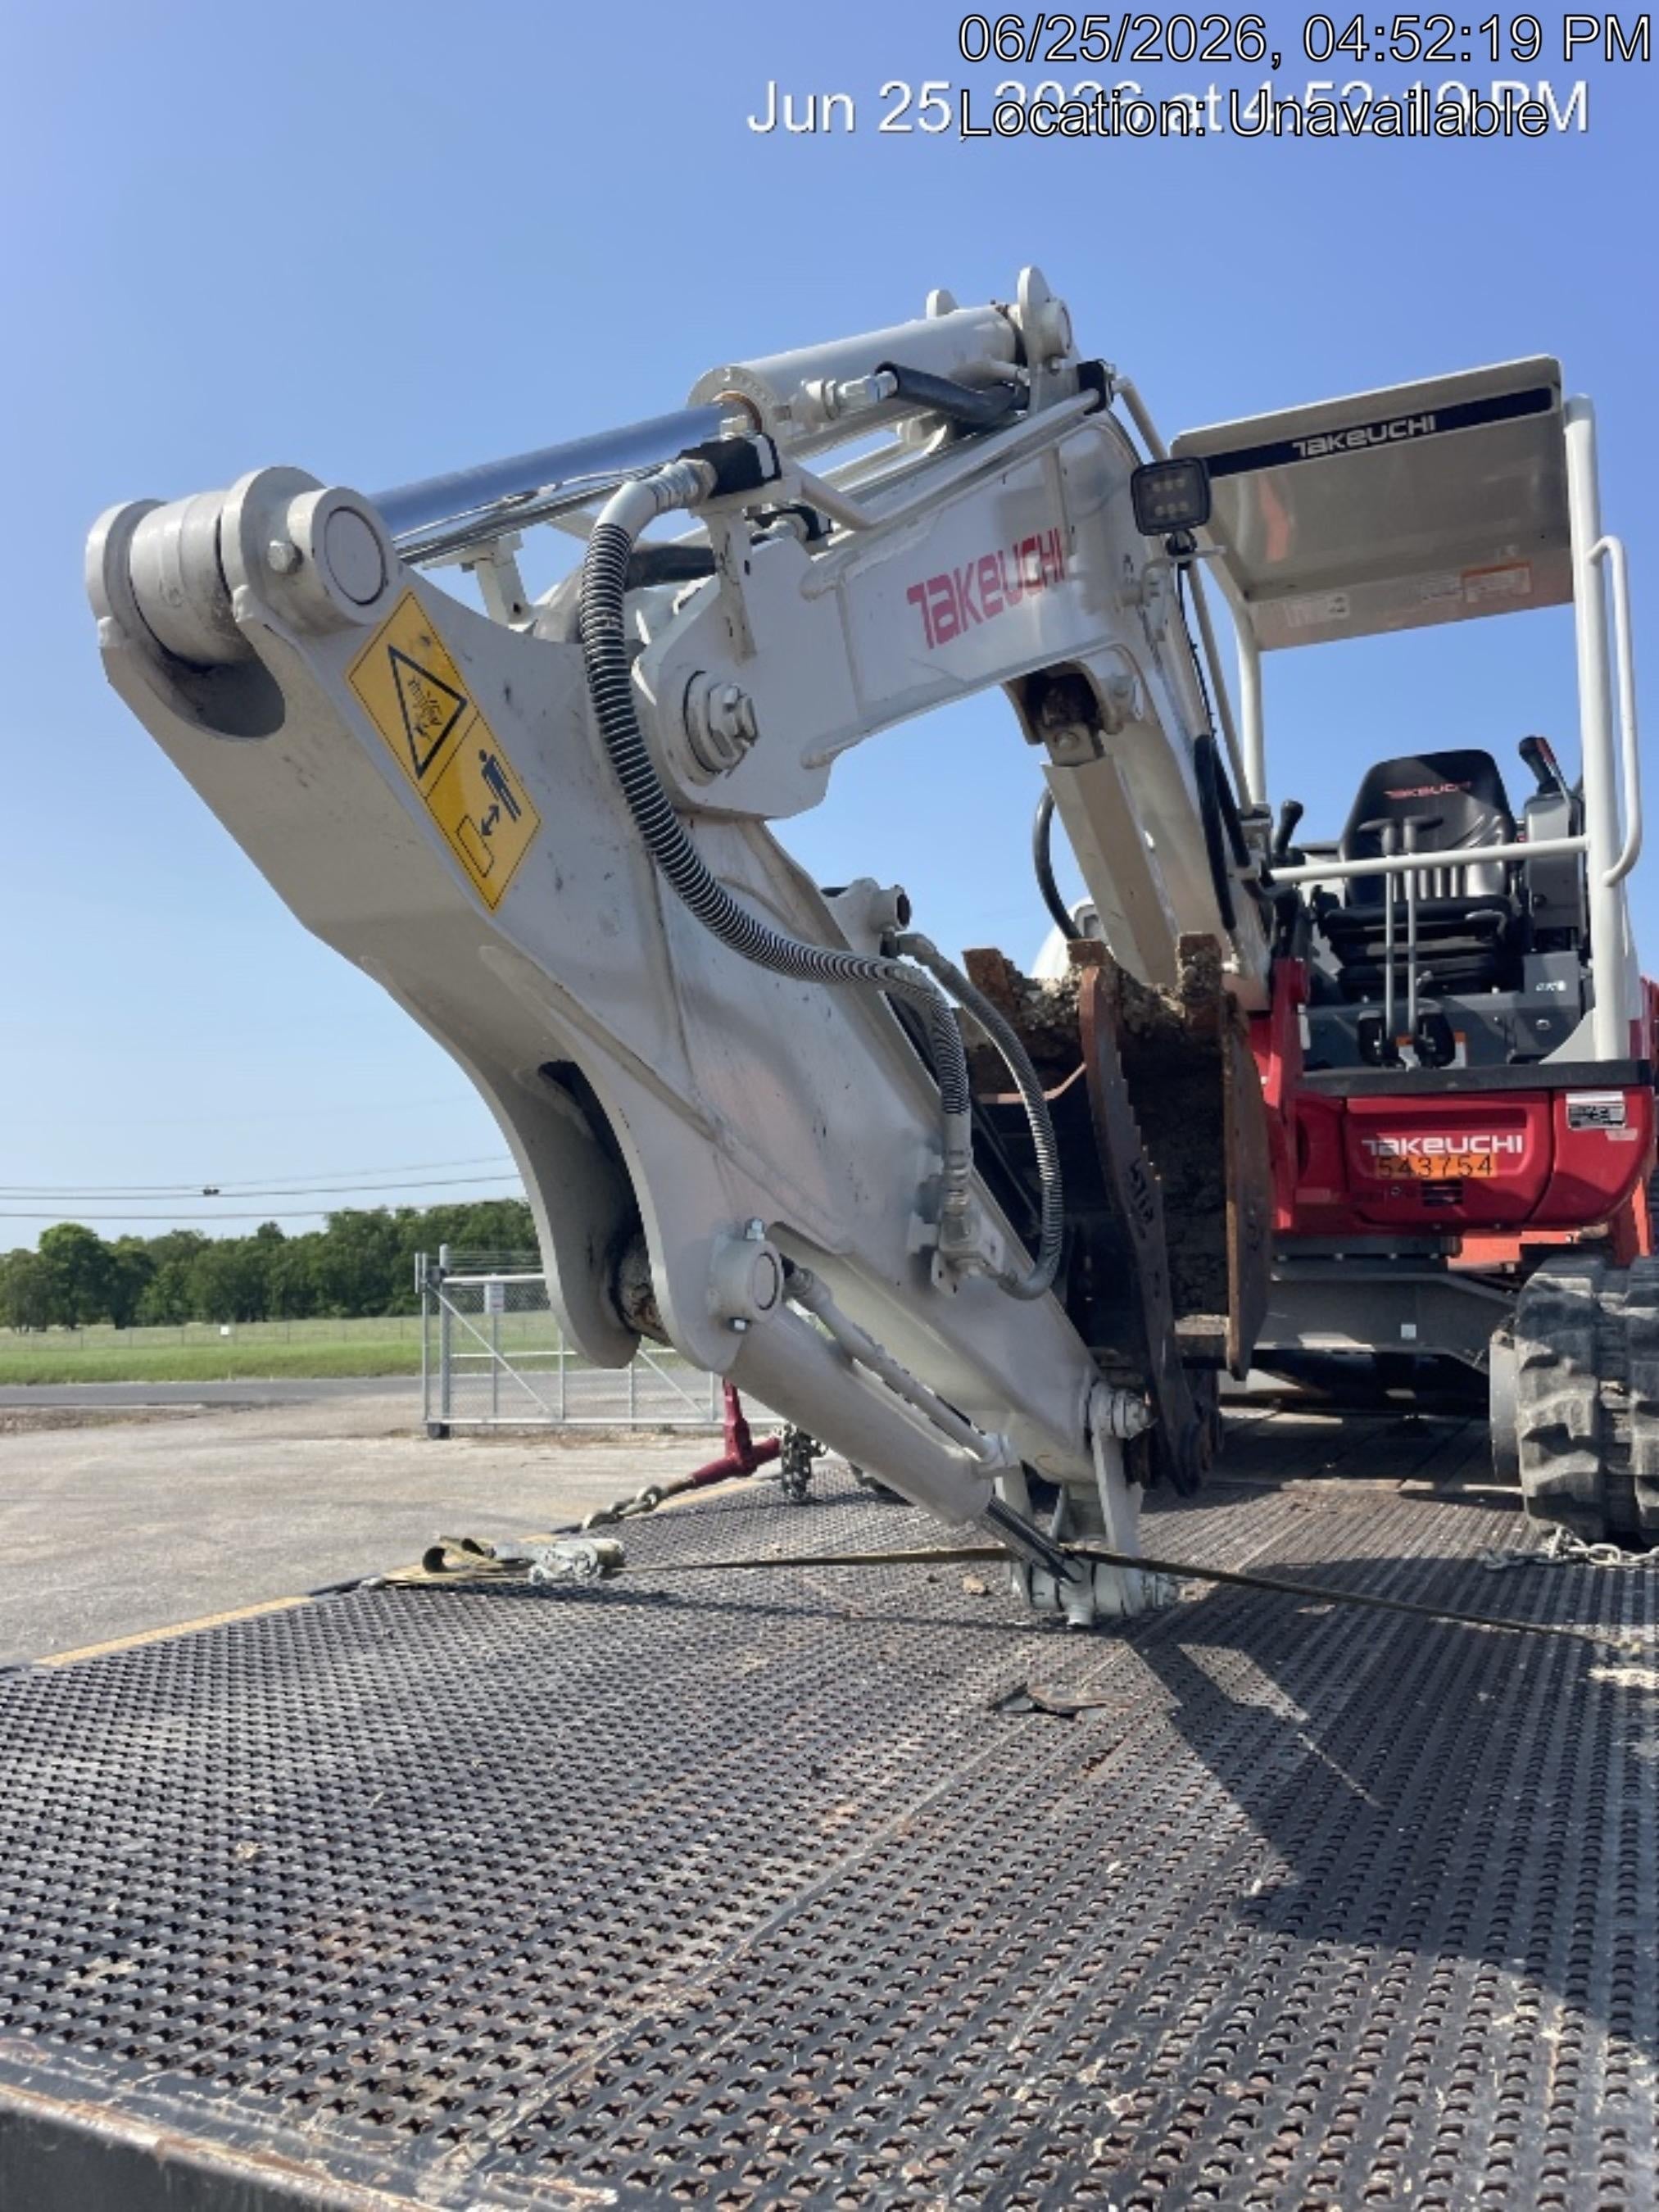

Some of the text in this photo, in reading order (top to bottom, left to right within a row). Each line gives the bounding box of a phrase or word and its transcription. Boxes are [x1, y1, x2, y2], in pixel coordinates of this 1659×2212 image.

[1292, 414, 1437, 458] TAKEUCHI
[906, 527, 1066, 650] TAKEUCHI
[1383, 781, 1472, 800] TAKEUC
[1362, 1134, 1523, 1156] TAKEUCHI
[1378, 1154, 1493, 1178] 543754
